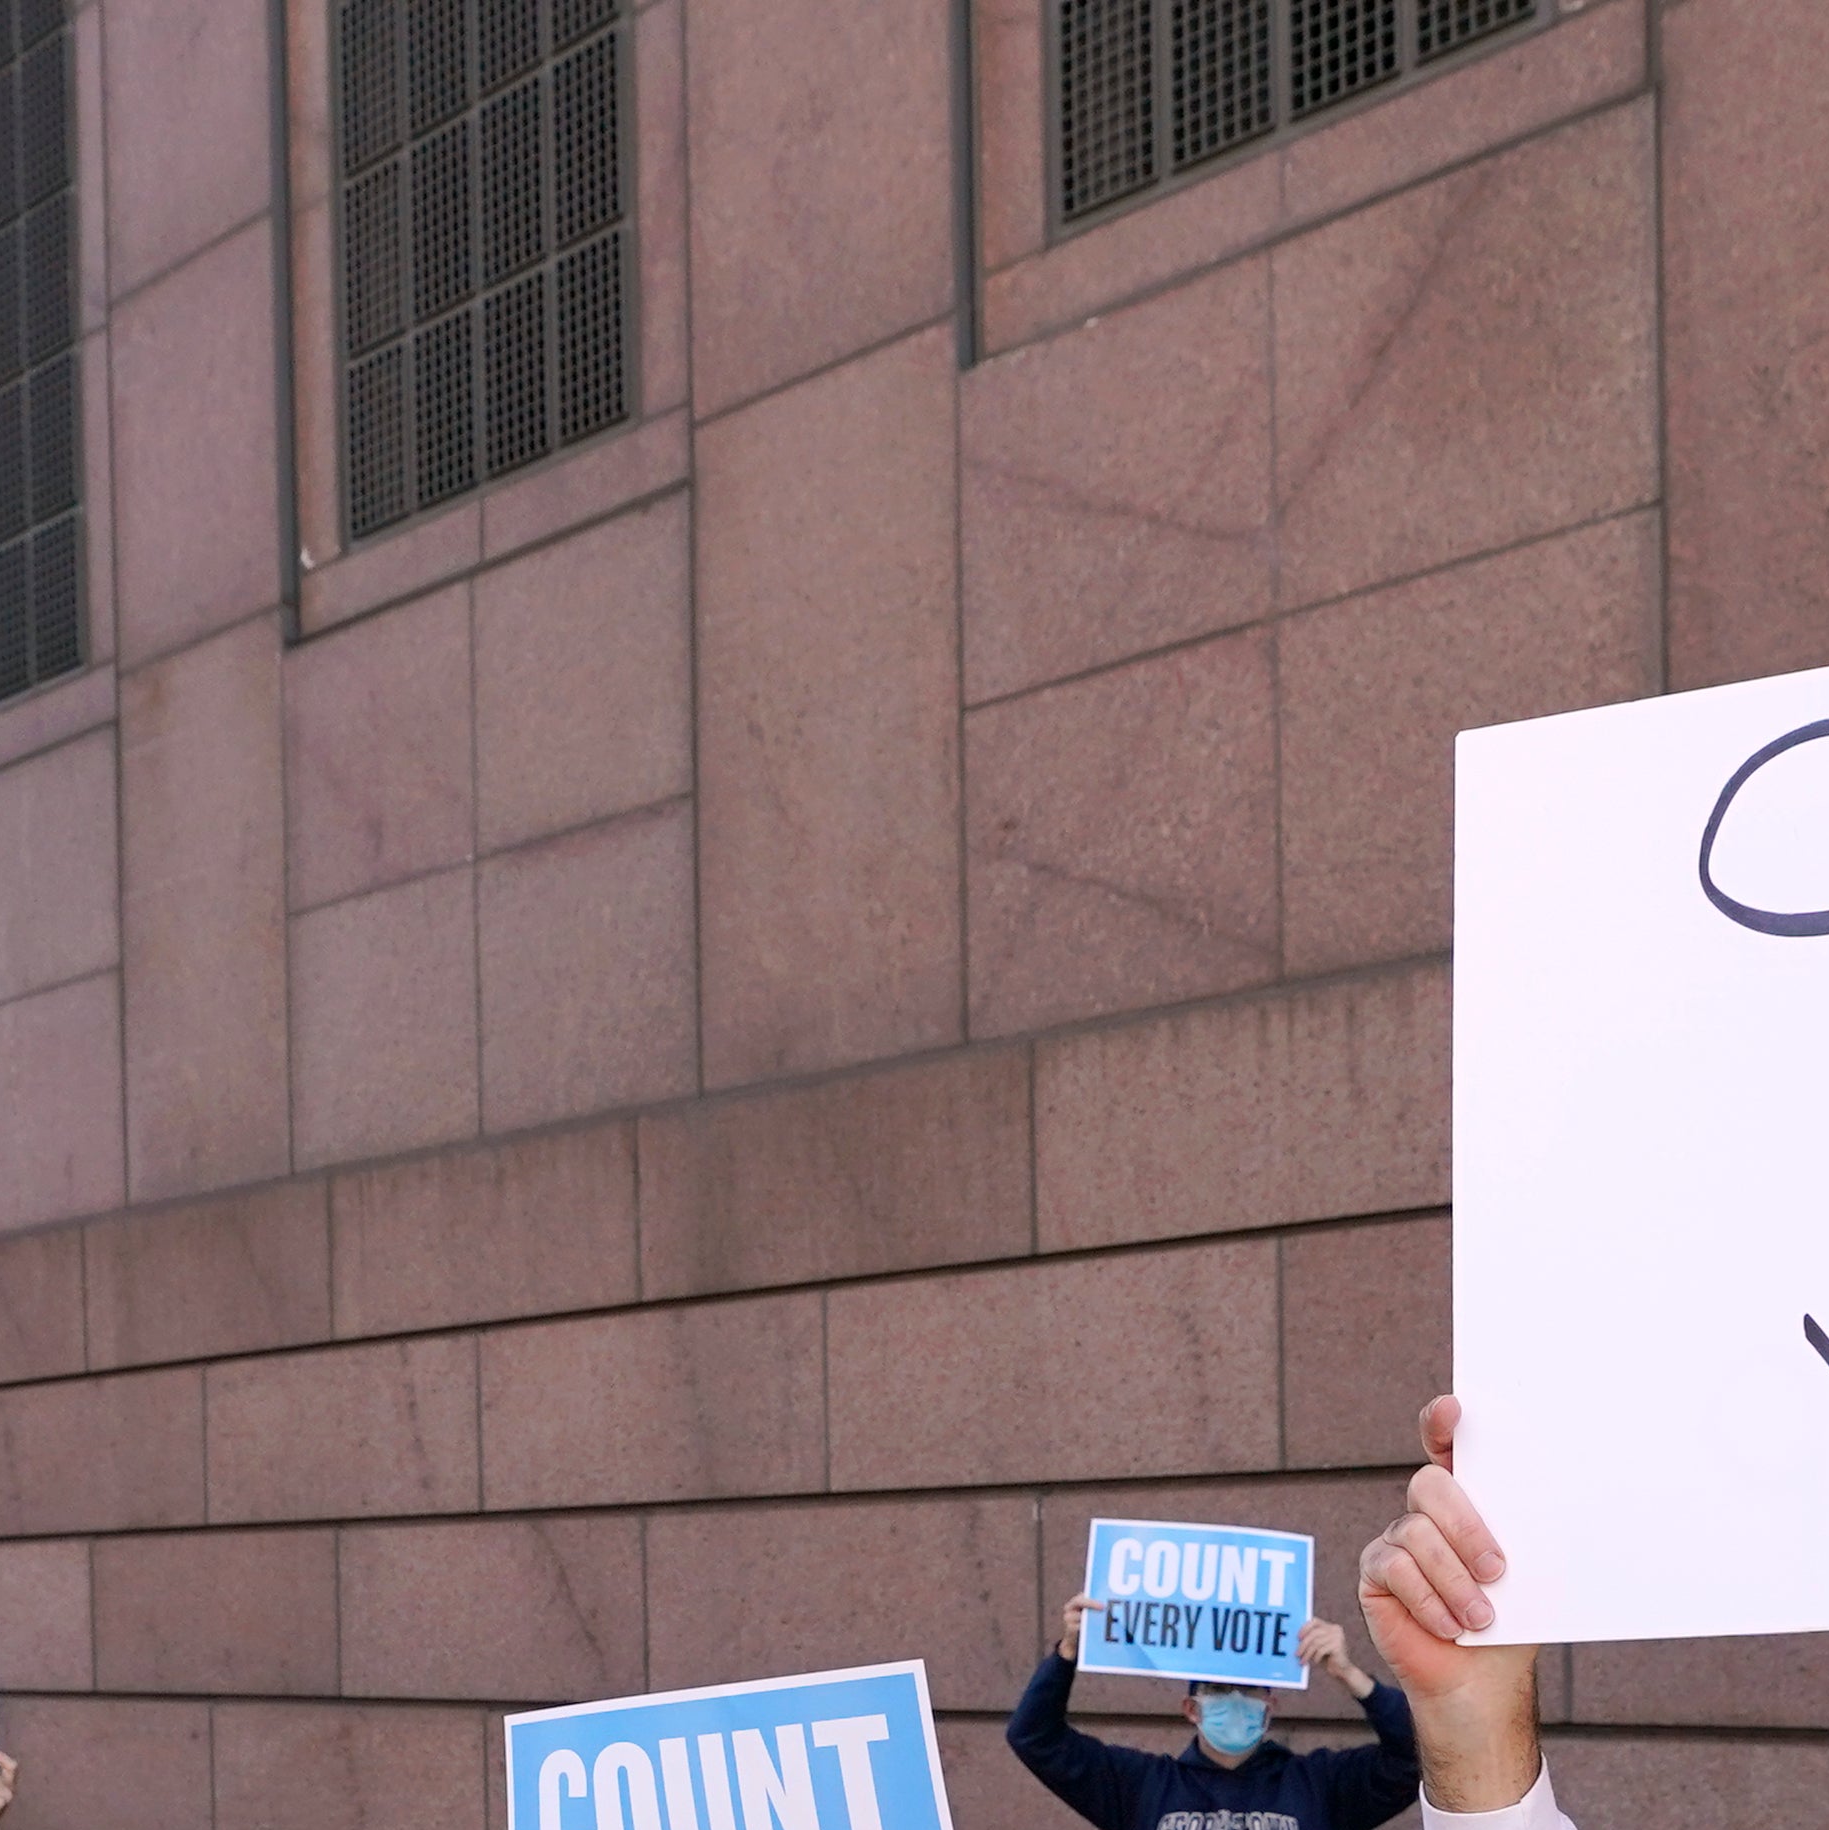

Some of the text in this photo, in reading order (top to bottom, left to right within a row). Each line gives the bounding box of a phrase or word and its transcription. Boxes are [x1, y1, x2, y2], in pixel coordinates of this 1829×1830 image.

[1107, 1537, 1296, 1608] COUNT
[1104, 1599, 1291, 1658] EVERY VOTE
